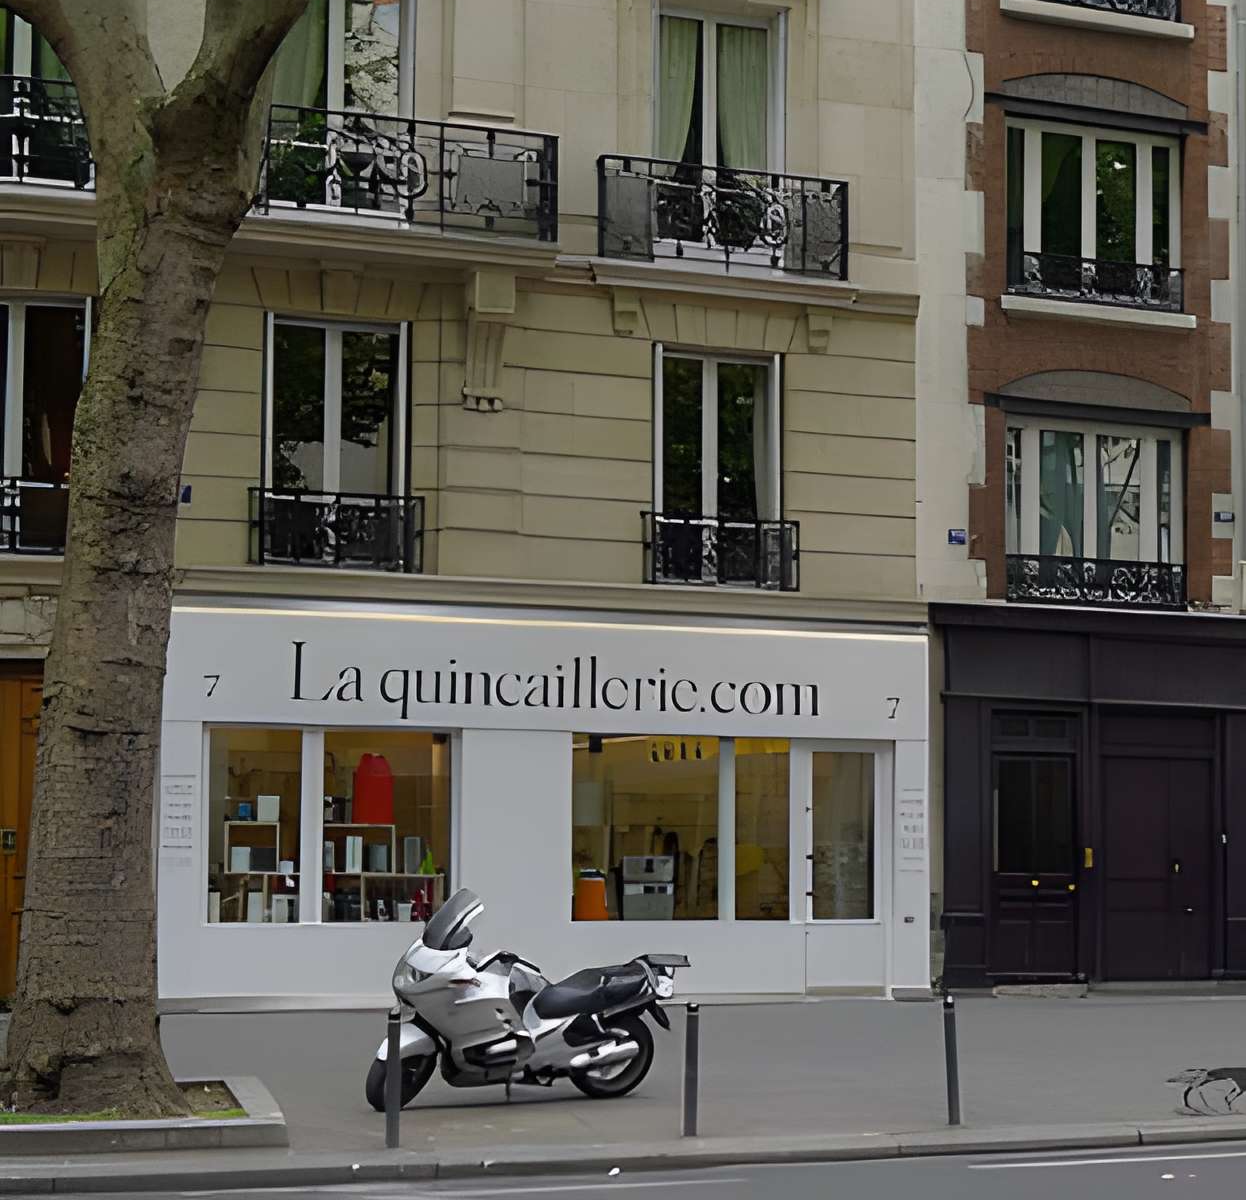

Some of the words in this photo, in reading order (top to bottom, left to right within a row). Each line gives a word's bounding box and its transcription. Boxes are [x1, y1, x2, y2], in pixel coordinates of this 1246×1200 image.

[289, 640, 364, 703] La
[203, 674, 220, 697] 7
[886, 697, 901, 720] 7
